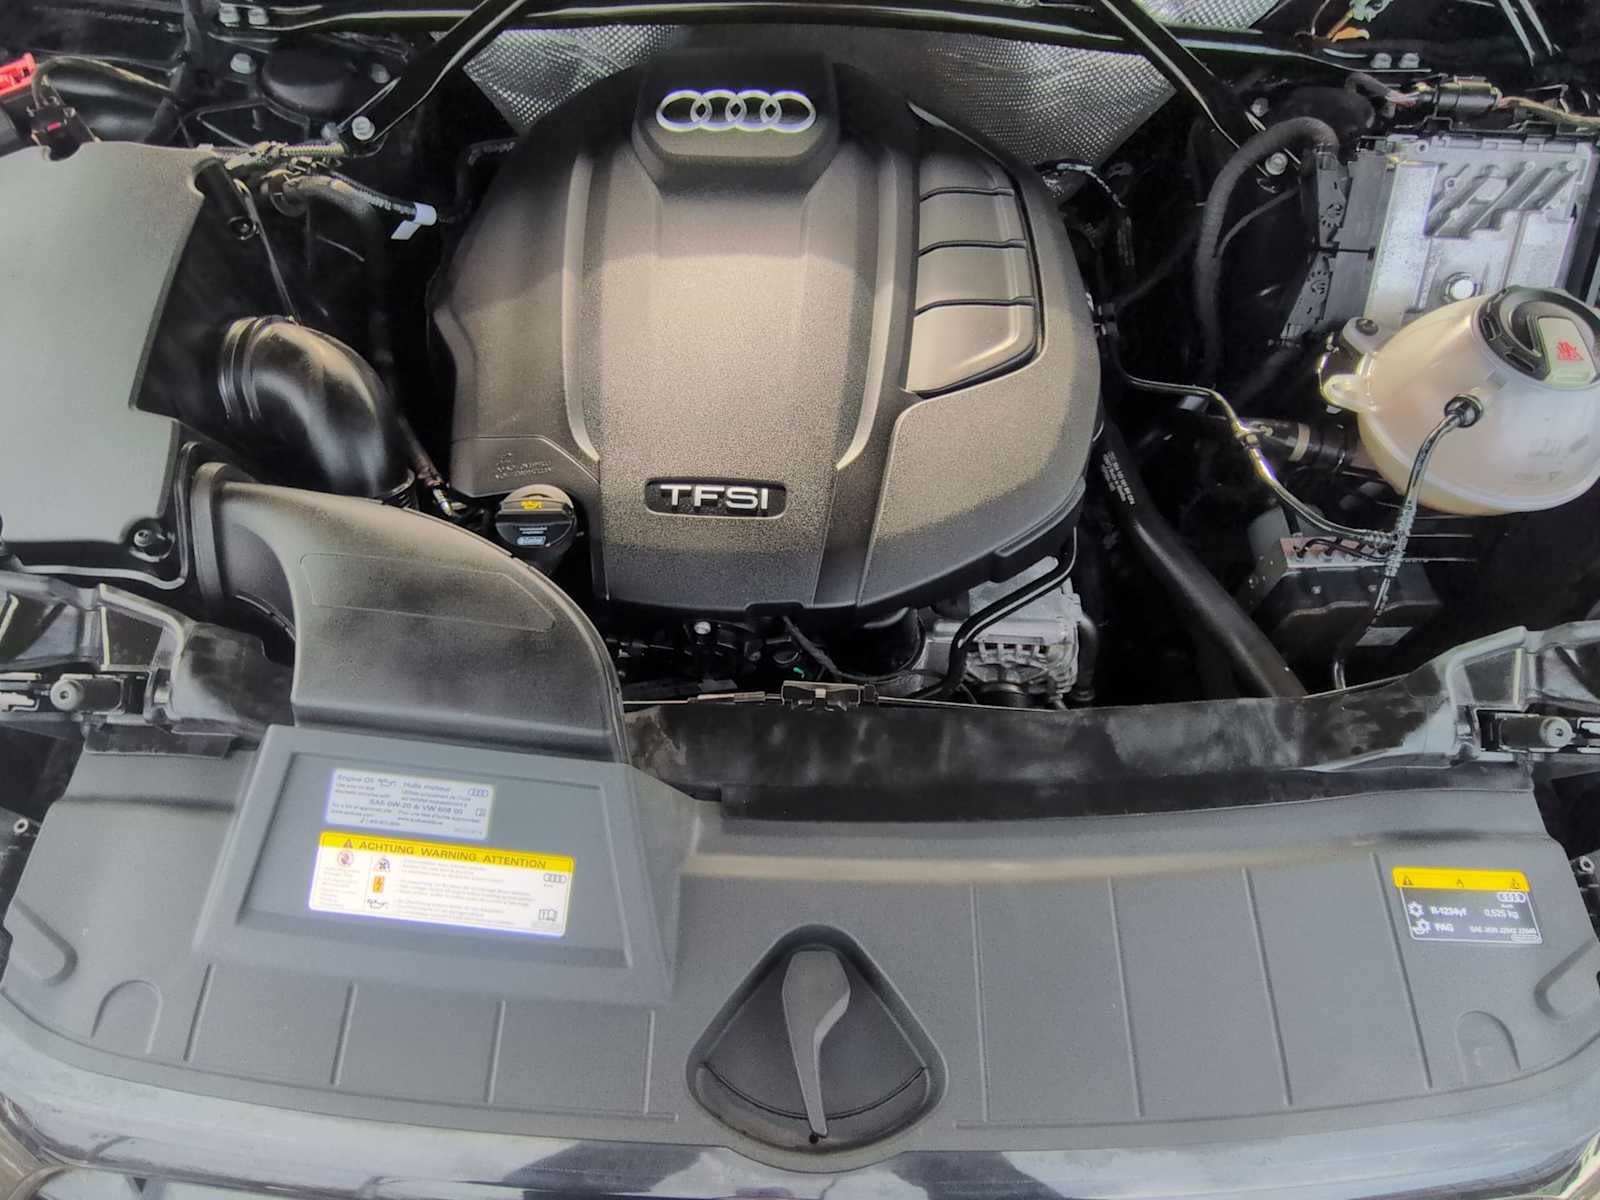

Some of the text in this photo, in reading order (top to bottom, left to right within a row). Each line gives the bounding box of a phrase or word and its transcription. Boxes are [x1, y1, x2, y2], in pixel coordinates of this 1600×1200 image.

[660, 484, 769, 510] TFSI
[358, 841, 547, 870] ACHTUNG WARNING ATTENTION
